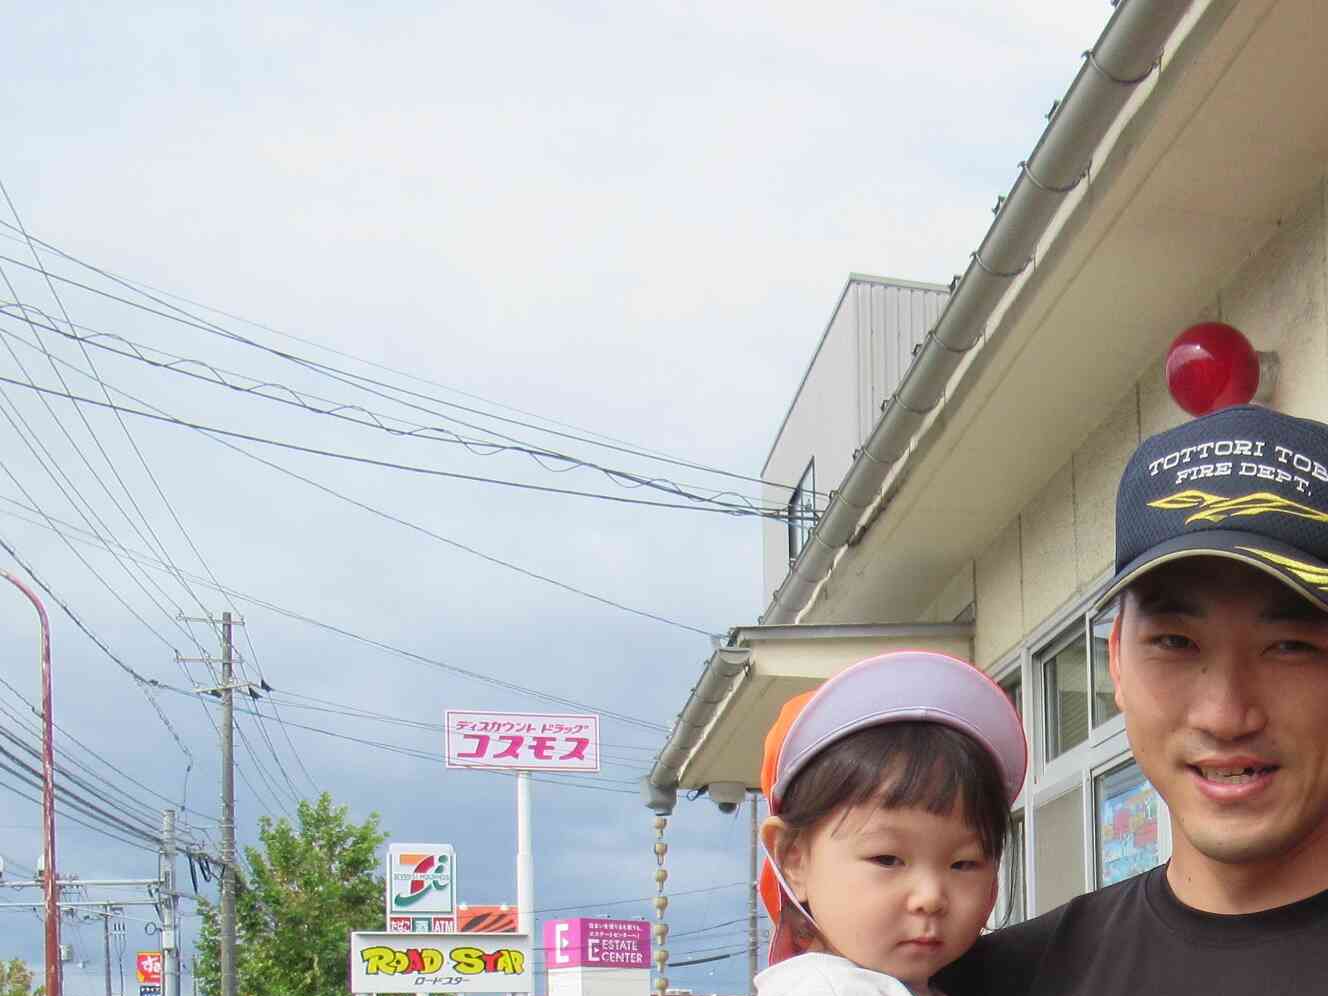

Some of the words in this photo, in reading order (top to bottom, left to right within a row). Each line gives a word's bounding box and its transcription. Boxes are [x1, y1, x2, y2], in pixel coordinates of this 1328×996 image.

[1149, 440, 1264, 476] TOTTORI
[1175, 462, 1232, 484] FIRE
[1239, 463, 1312, 496] DEPT.
[456, 720, 537, 733] ディスカウント
[541, 723, 590, 735] ドラッグ
[457, 734, 590, 760] コスモス
[434, 920, 455, 933] ATM
[602, 940, 638, 951] ESTATE
[361, 946, 444, 975] ROAD
[450, 947, 525, 975] STAR
[601, 952, 643, 963] CENTER
[414, 976, 471, 985] ロードスター
